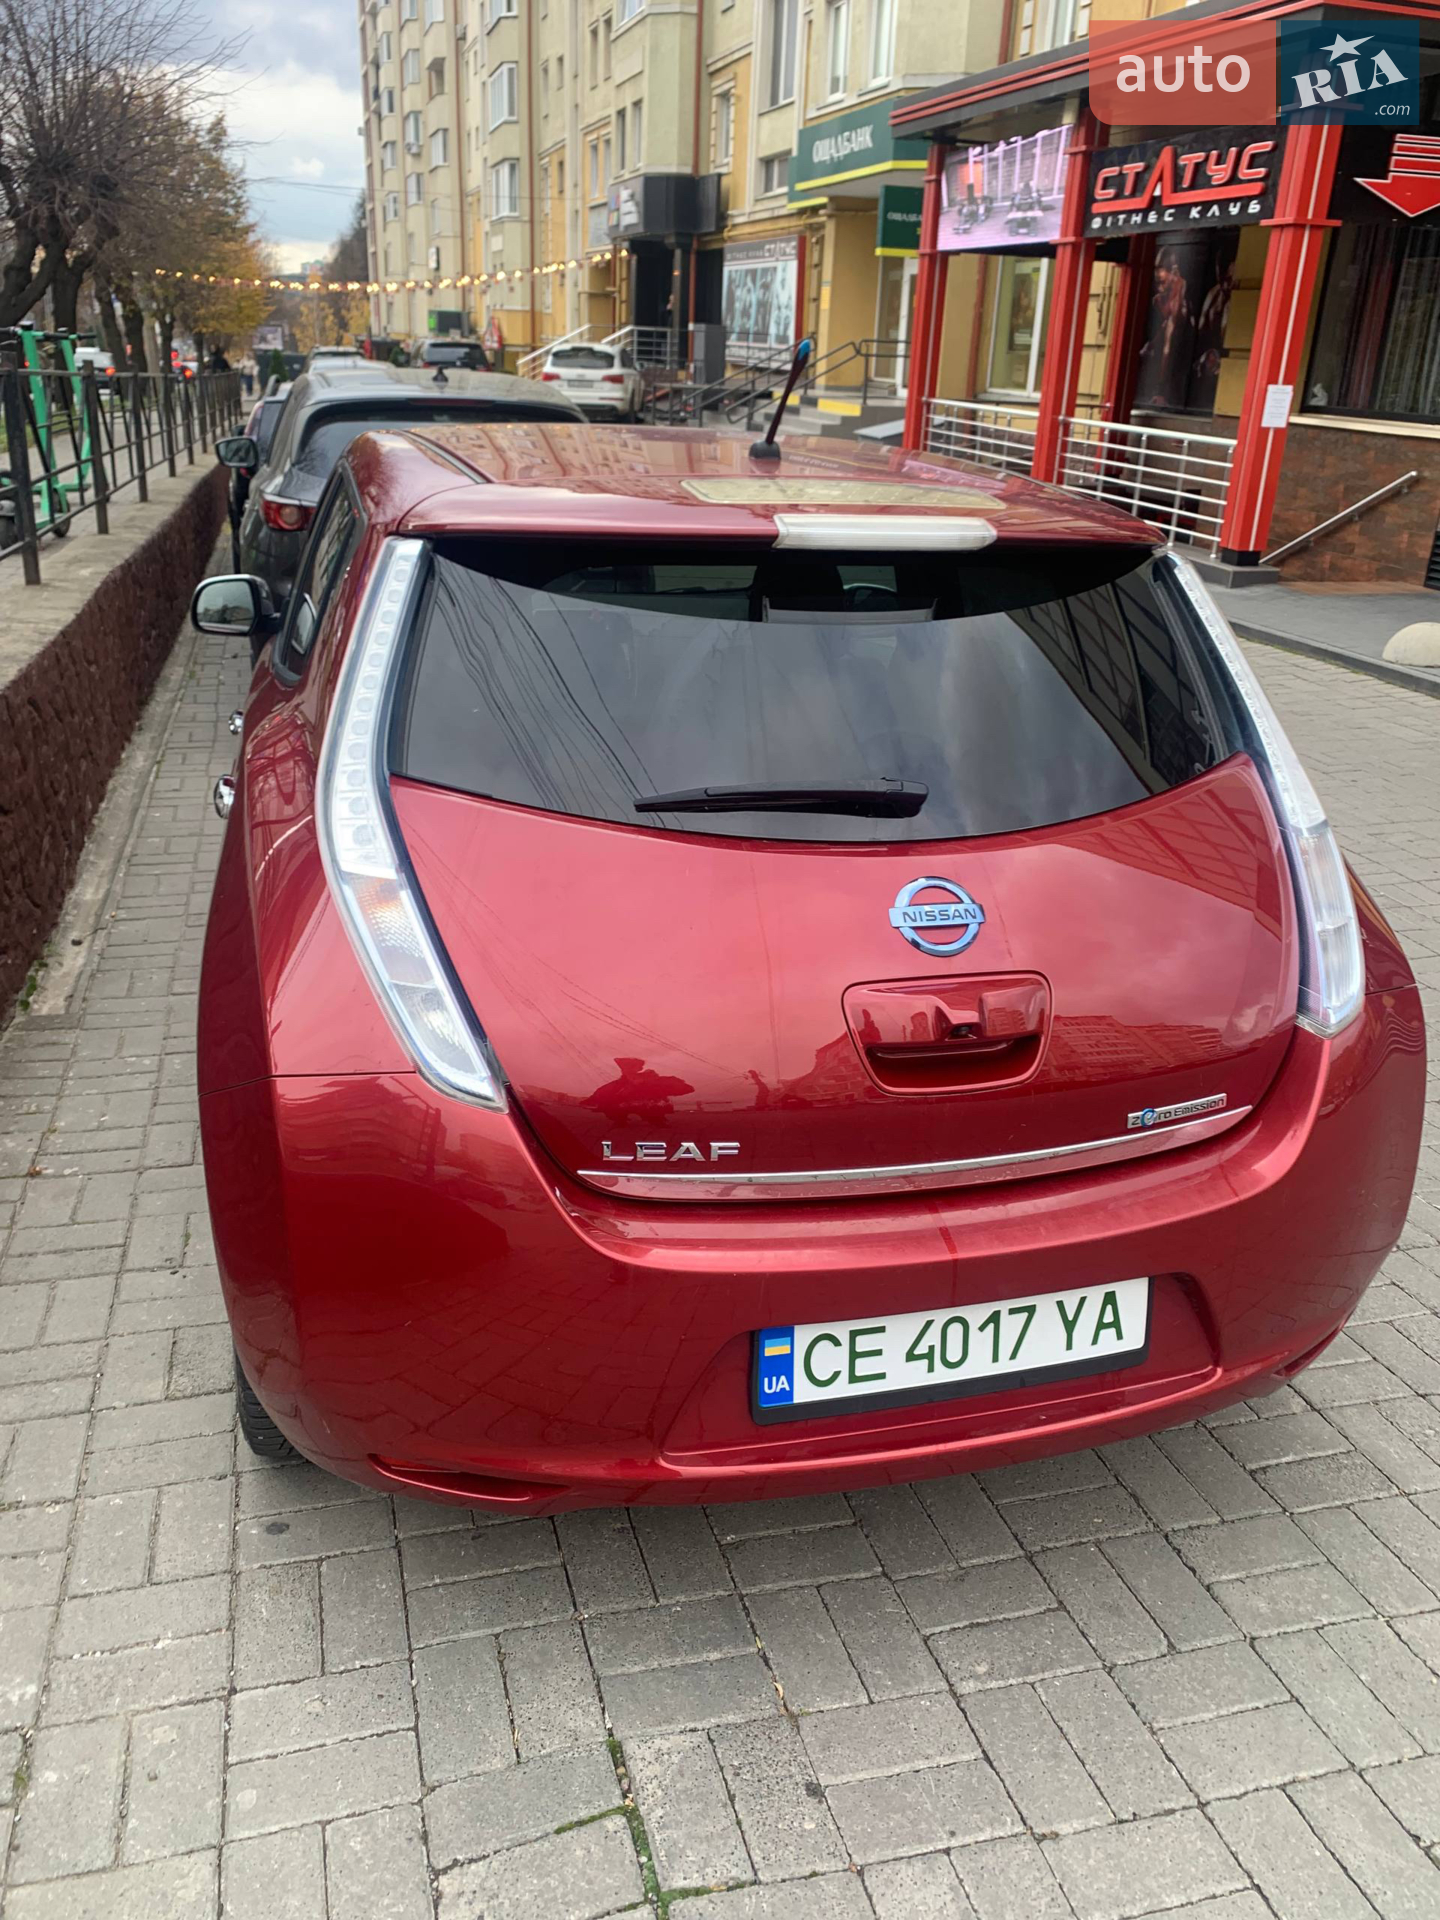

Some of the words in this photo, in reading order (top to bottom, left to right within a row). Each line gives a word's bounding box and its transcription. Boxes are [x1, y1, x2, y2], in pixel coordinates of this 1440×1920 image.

[811, 124, 874, 164] ОЩАДБАНК
[1092, 140, 1277, 205] СТАТУС
[1090, 208, 1176, 229] ФІТНЕС
[1189, 199, 1262, 219] КЛУБ
[902, 908, 977, 923] NISSAN
[601, 1141, 741, 1162] LEAF
[803, 1325, 887, 1388] CE
[905, 1303, 1037, 1374] 4017
[1055, 1290, 1124, 1351] YA
[764, 1374, 790, 1394] UA
